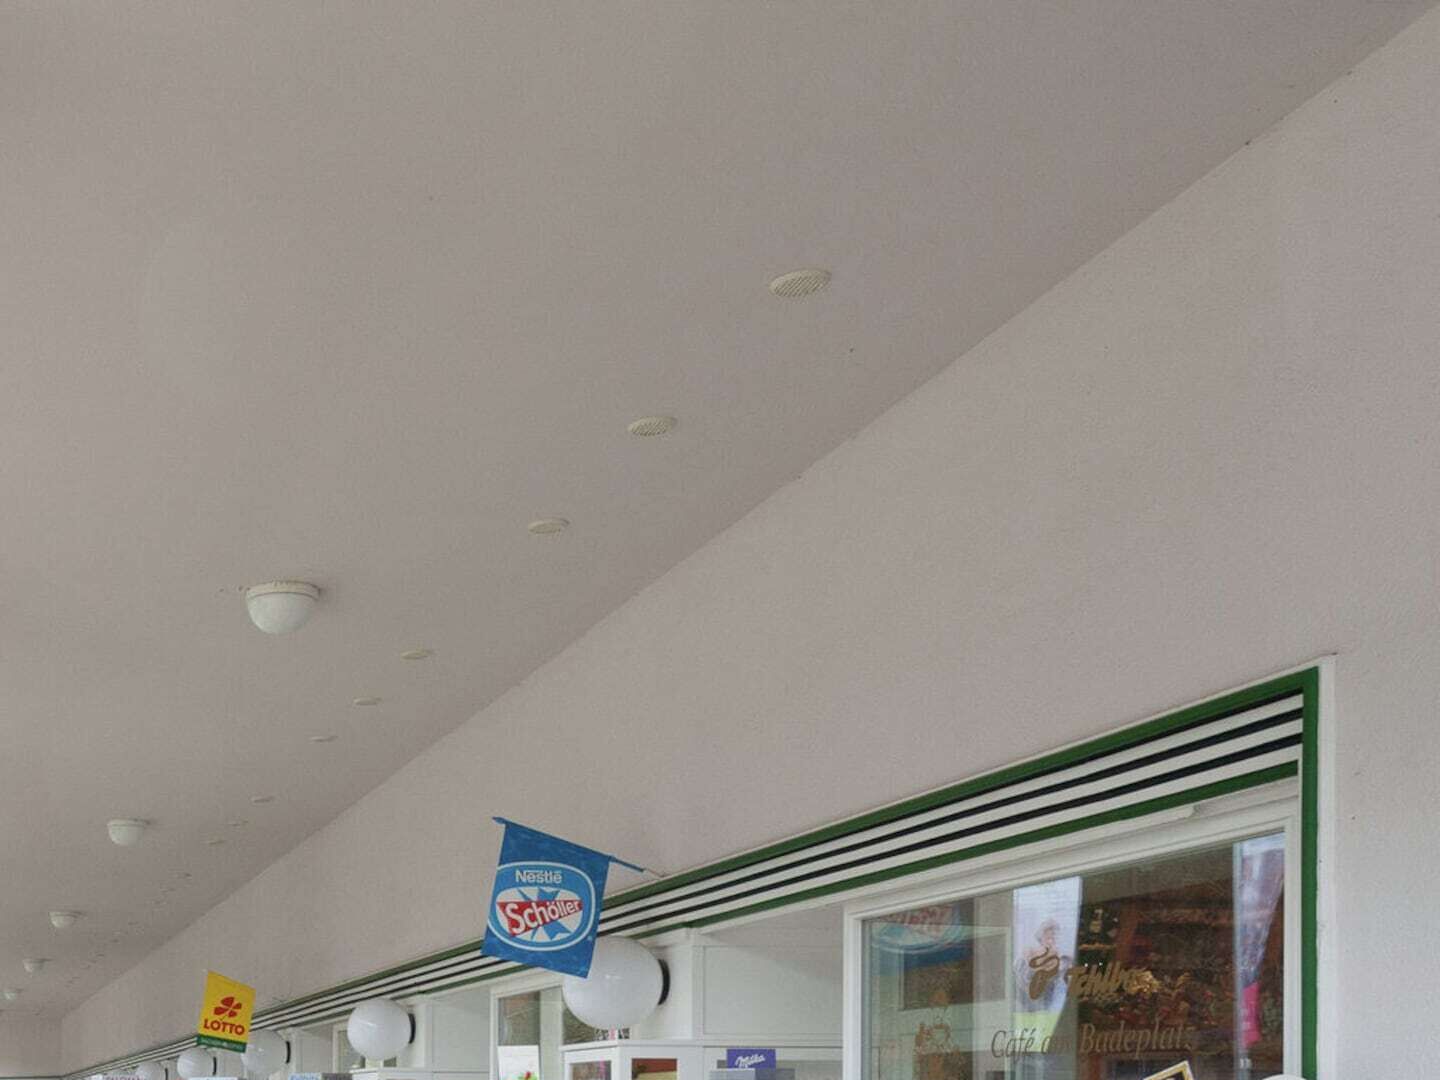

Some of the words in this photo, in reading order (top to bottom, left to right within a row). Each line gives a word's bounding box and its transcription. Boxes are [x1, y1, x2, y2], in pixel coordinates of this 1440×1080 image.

[505, 900, 581, 934] Schöller
[203, 1018, 245, 1036] LOTTO
[991, 1027, 1036, 1064] Café
[734, 1054, 766, 1069] Milka
